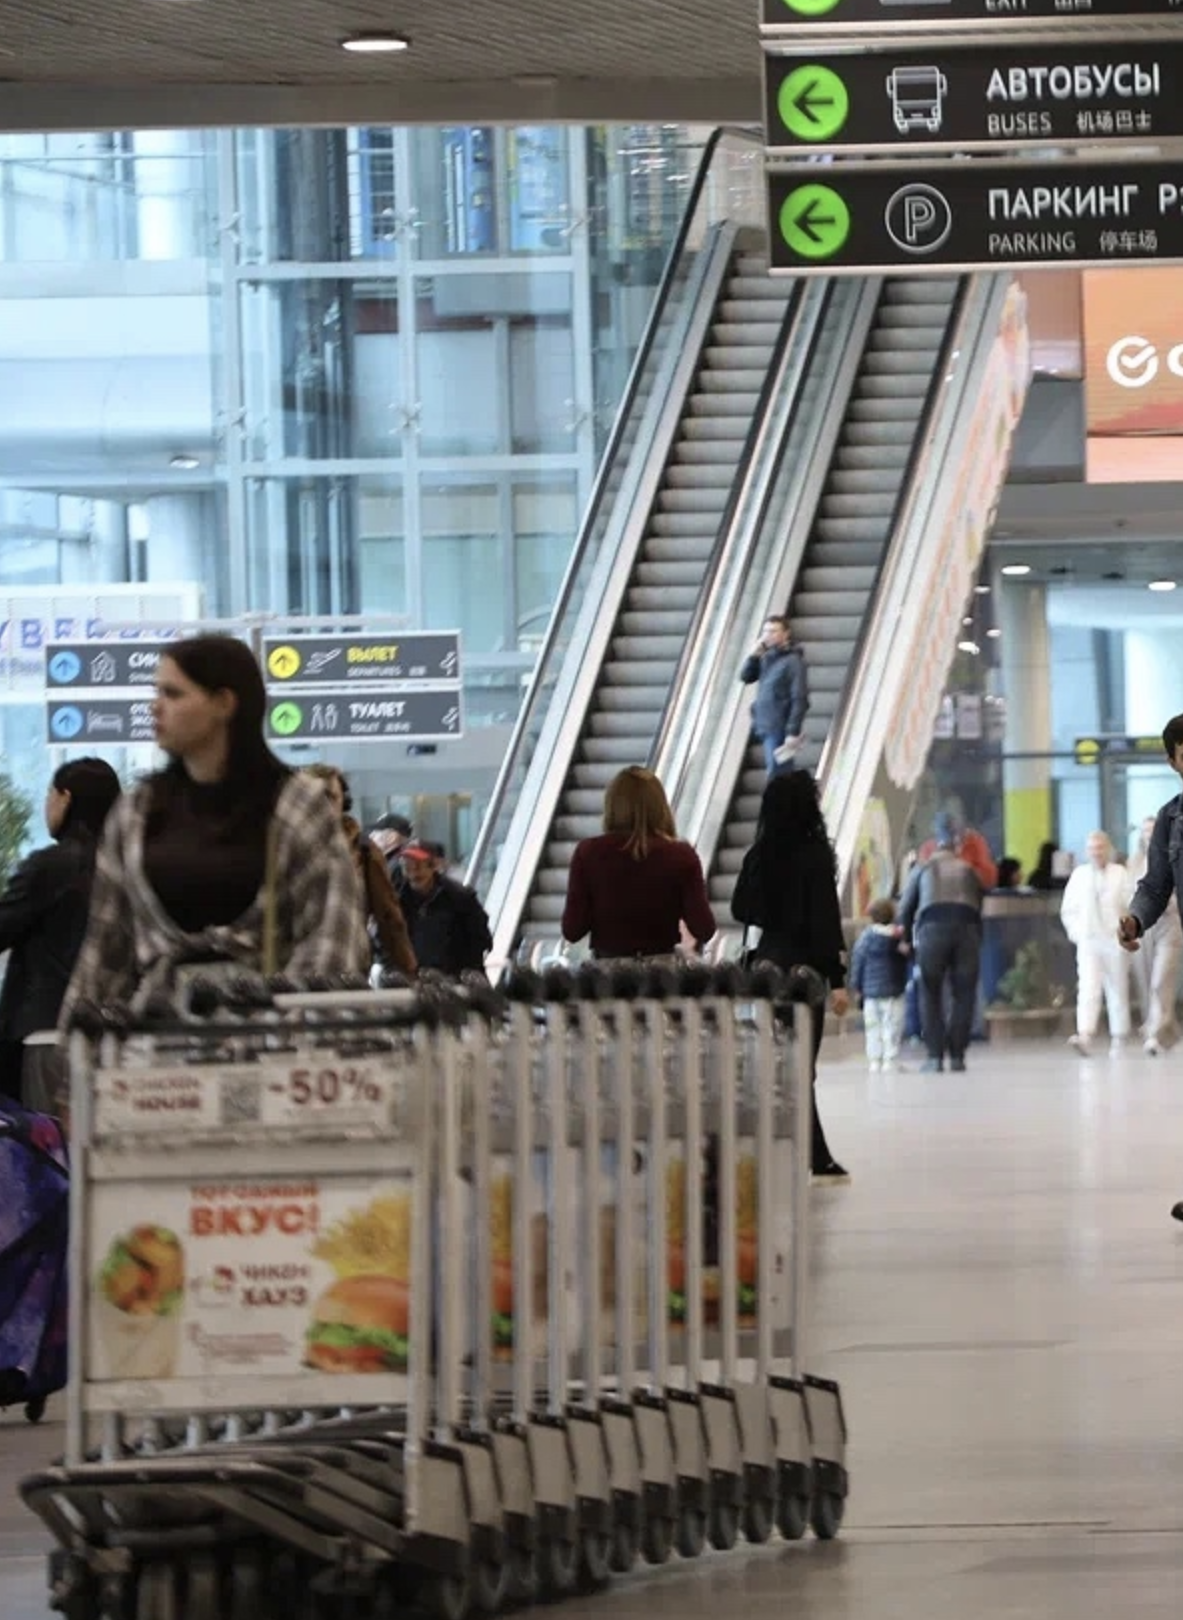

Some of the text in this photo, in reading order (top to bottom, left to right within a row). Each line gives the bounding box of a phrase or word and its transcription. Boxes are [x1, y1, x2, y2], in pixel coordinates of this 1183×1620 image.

[986, 62, 1160, 100] АВТОБУСЫ
[988, 112, 1052, 137] BUSES
[988, 184, 1138, 220] ПАРКИНГ
[988, 231, 1076, 254] PARKING
[347, 645, 399, 663] ВЫЛЕТ
[349, 701, 406, 718] ТУАЛЕТ
[268, 1067, 382, 1104] -50%
[190, 1205, 321, 1237] ВКУС!
